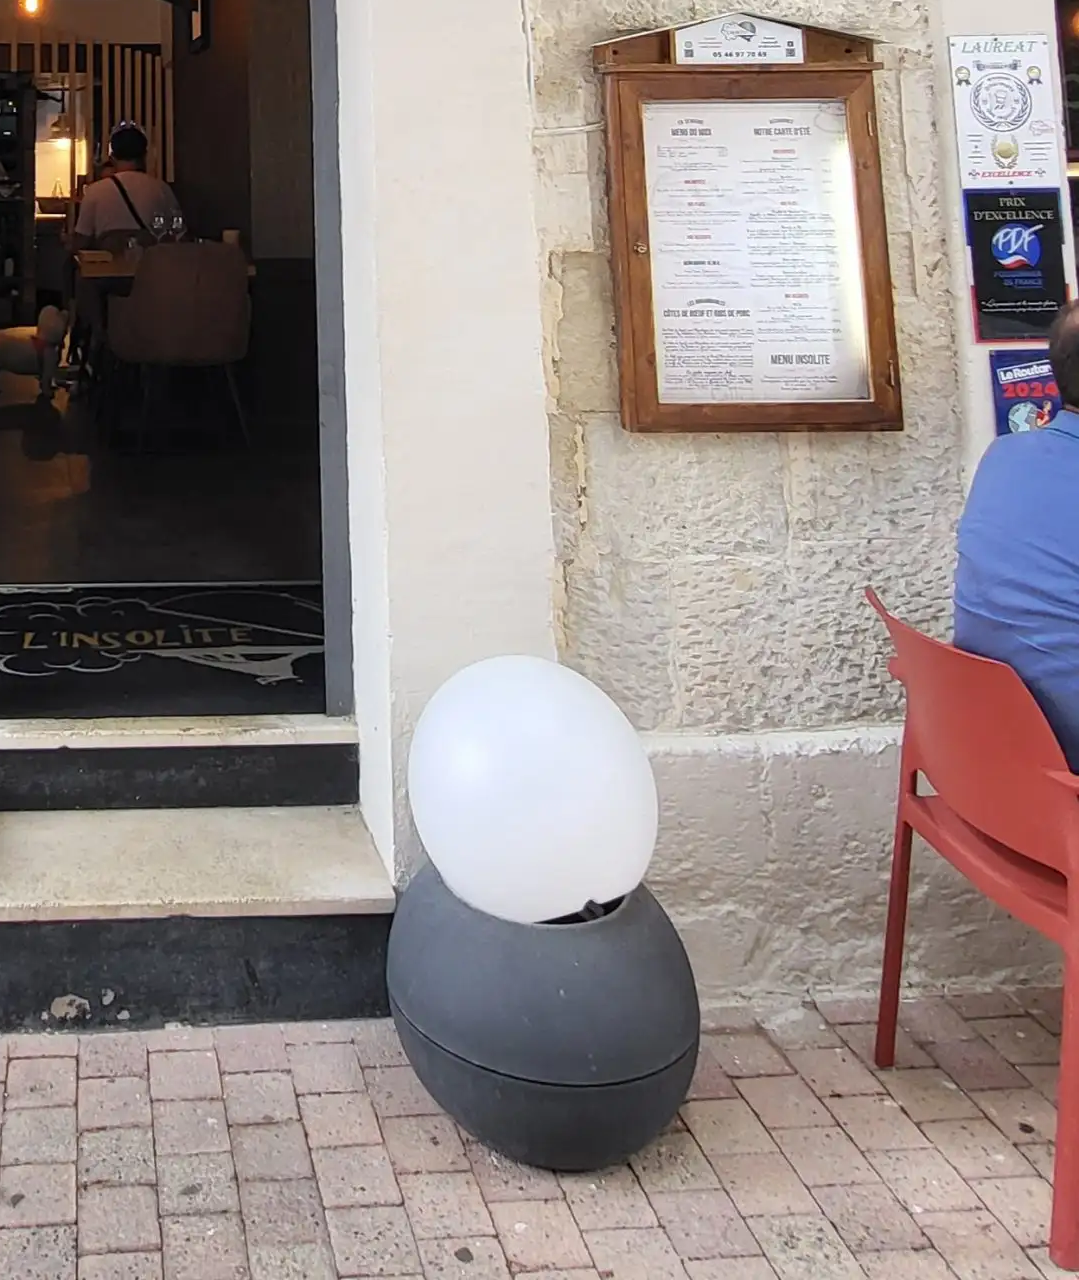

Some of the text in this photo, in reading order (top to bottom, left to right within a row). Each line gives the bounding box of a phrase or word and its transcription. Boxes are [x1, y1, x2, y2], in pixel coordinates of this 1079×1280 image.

[980, 170, 1034, 178] EXCELLENCE
[998, 197, 1026, 207] PRIX
[973, 209, 1055, 221] D'EXCELLENCE
[992, 223, 1044, 254] PDF
[770, 354, 831, 365] MENU INSOLITE
[1012, 364, 1053, 378] Routar
[1002, 381, 1060, 399] 2024
